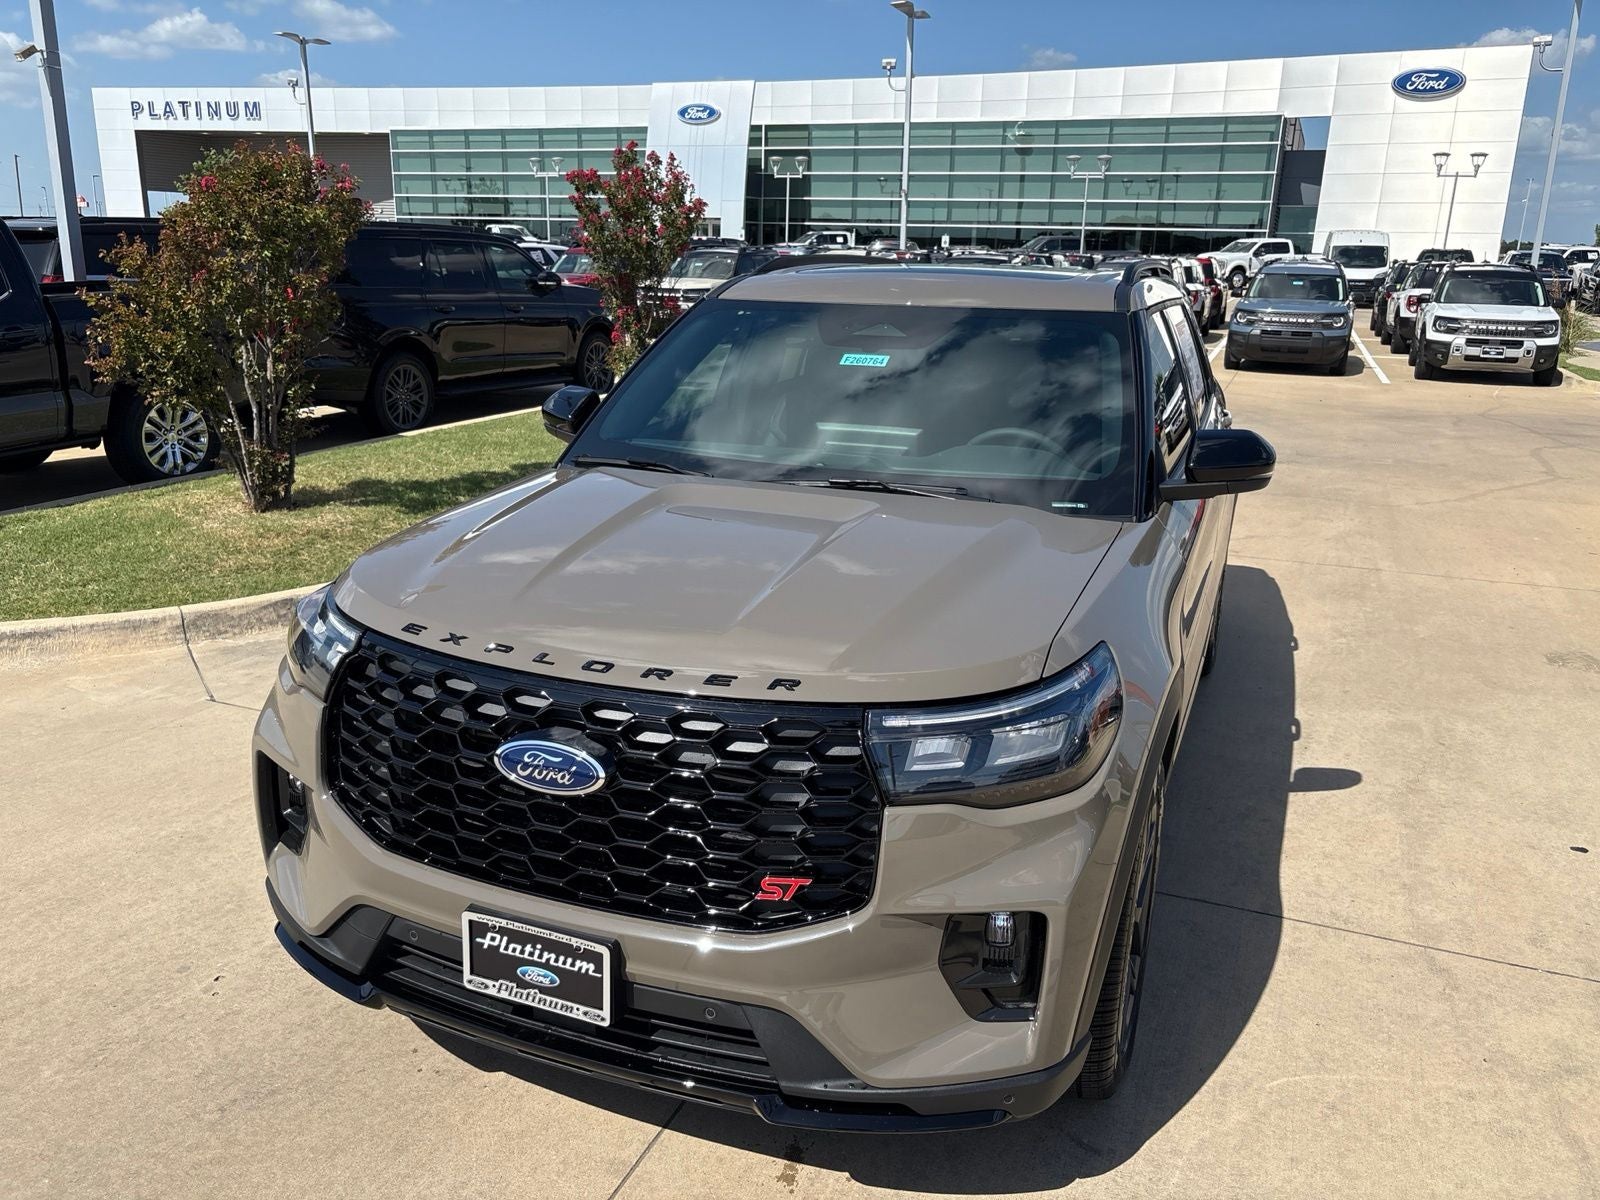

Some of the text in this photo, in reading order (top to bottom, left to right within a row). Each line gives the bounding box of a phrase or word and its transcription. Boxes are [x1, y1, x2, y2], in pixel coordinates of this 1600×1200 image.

[1406, 72, 1450, 90] Ford
[130, 100, 262, 121] PLATINUM
[684, 106, 710, 119] Ford
[843, 356, 885, 365] F260764
[401, 622, 802, 692] EXPLORER
[517, 751, 577, 785] Ford
[755, 876, 813, 901] ST
[475, 932, 602, 977] Platinum
[496, 981, 575, 1014] Platinum
